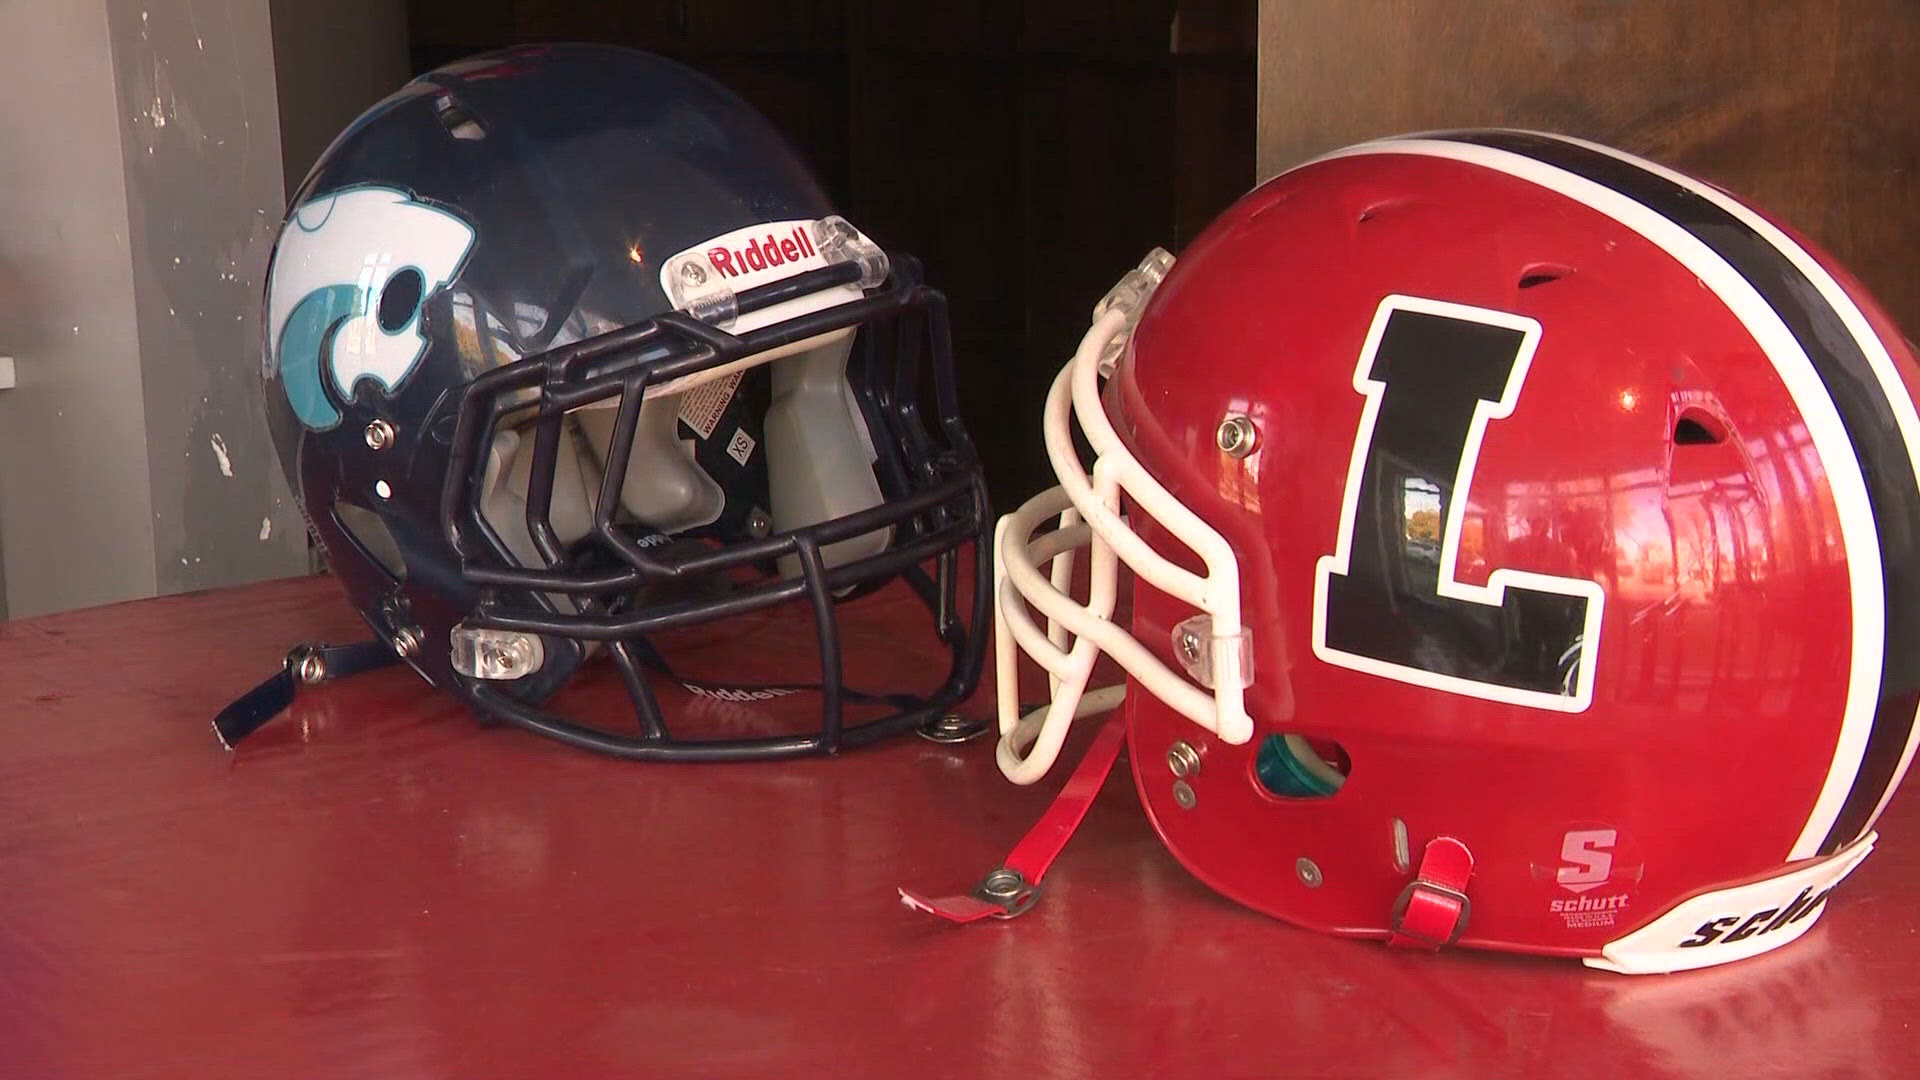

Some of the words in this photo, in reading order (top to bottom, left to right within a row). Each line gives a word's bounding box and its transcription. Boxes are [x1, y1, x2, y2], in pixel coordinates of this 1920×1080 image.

[707, 226, 816, 280] Riddell
[703, 392, 730, 435] WARNING
[732, 435, 748, 458] XS
[1313, 294, 1605, 713] L
[1557, 829, 1617, 883] S
[1549, 893, 1629, 912] schutt
